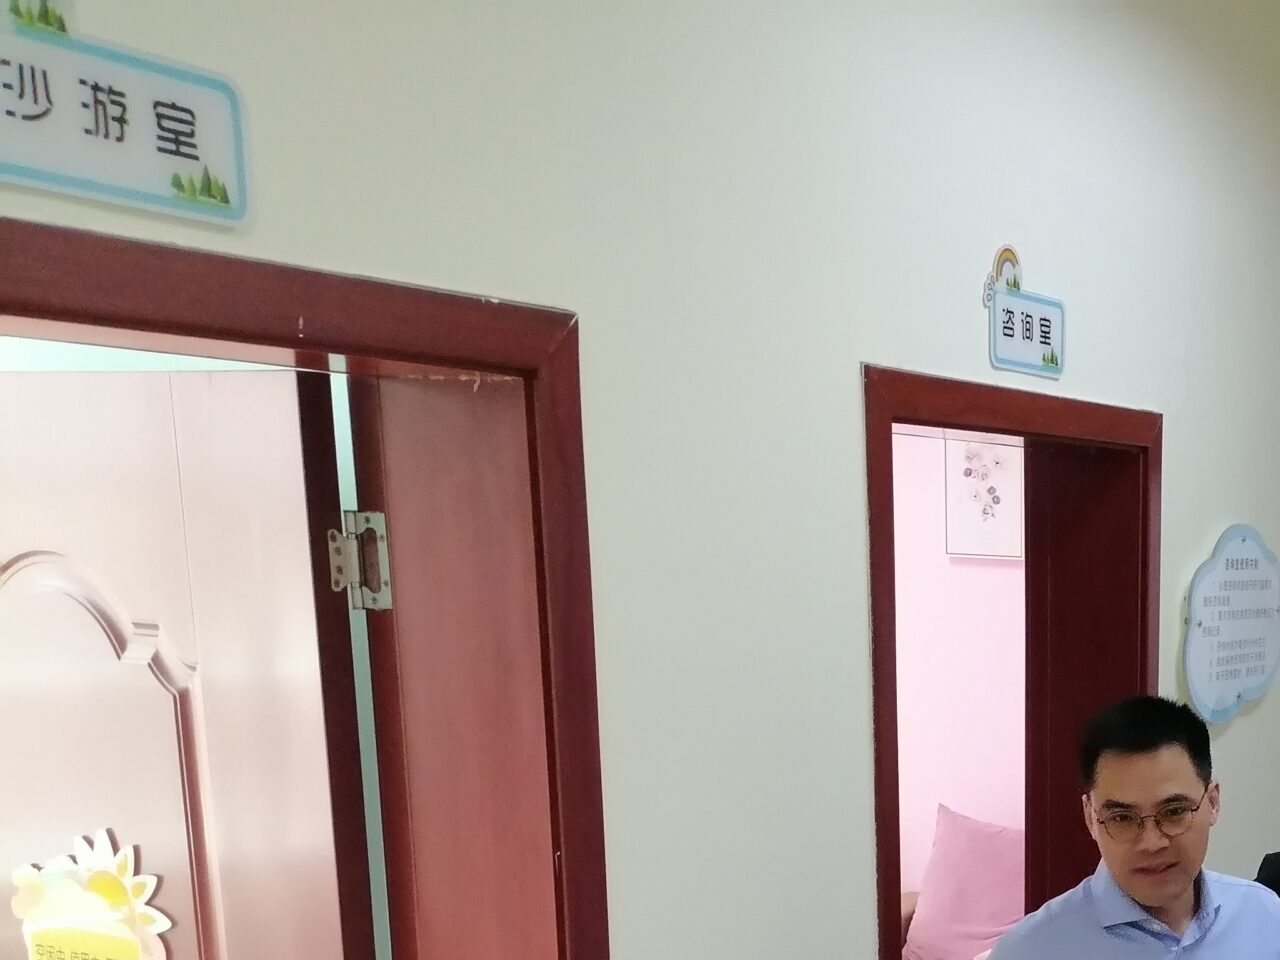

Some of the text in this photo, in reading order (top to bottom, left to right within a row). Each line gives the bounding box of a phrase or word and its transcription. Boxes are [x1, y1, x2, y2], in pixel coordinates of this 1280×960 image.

[0, 58, 200, 161] 沙游室
[1002, 307, 1052, 346] 咨询室
